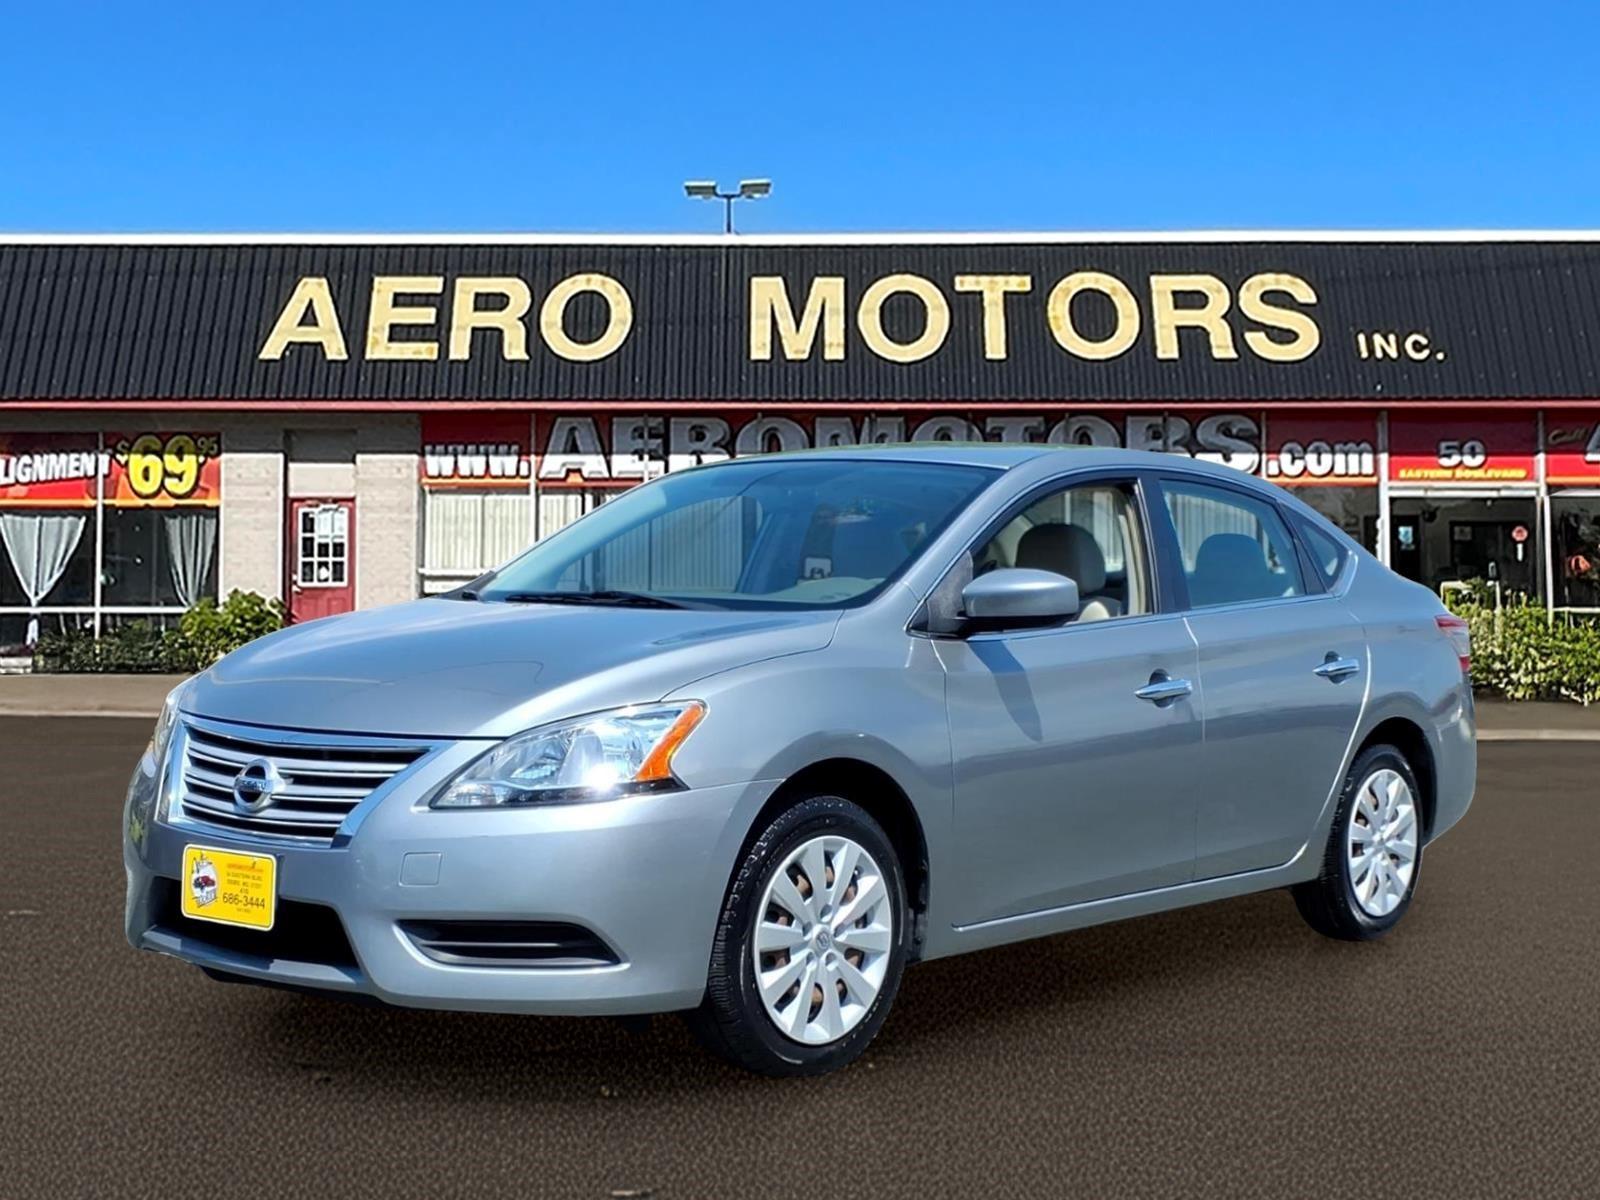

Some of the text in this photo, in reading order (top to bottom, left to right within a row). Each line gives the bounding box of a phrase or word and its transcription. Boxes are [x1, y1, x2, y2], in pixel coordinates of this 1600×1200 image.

[258, 272, 1445, 363] AERO MOTORS INC.
[1437, 440, 1486, 467] 50
[222, 891, 266, 909] 686-3444
